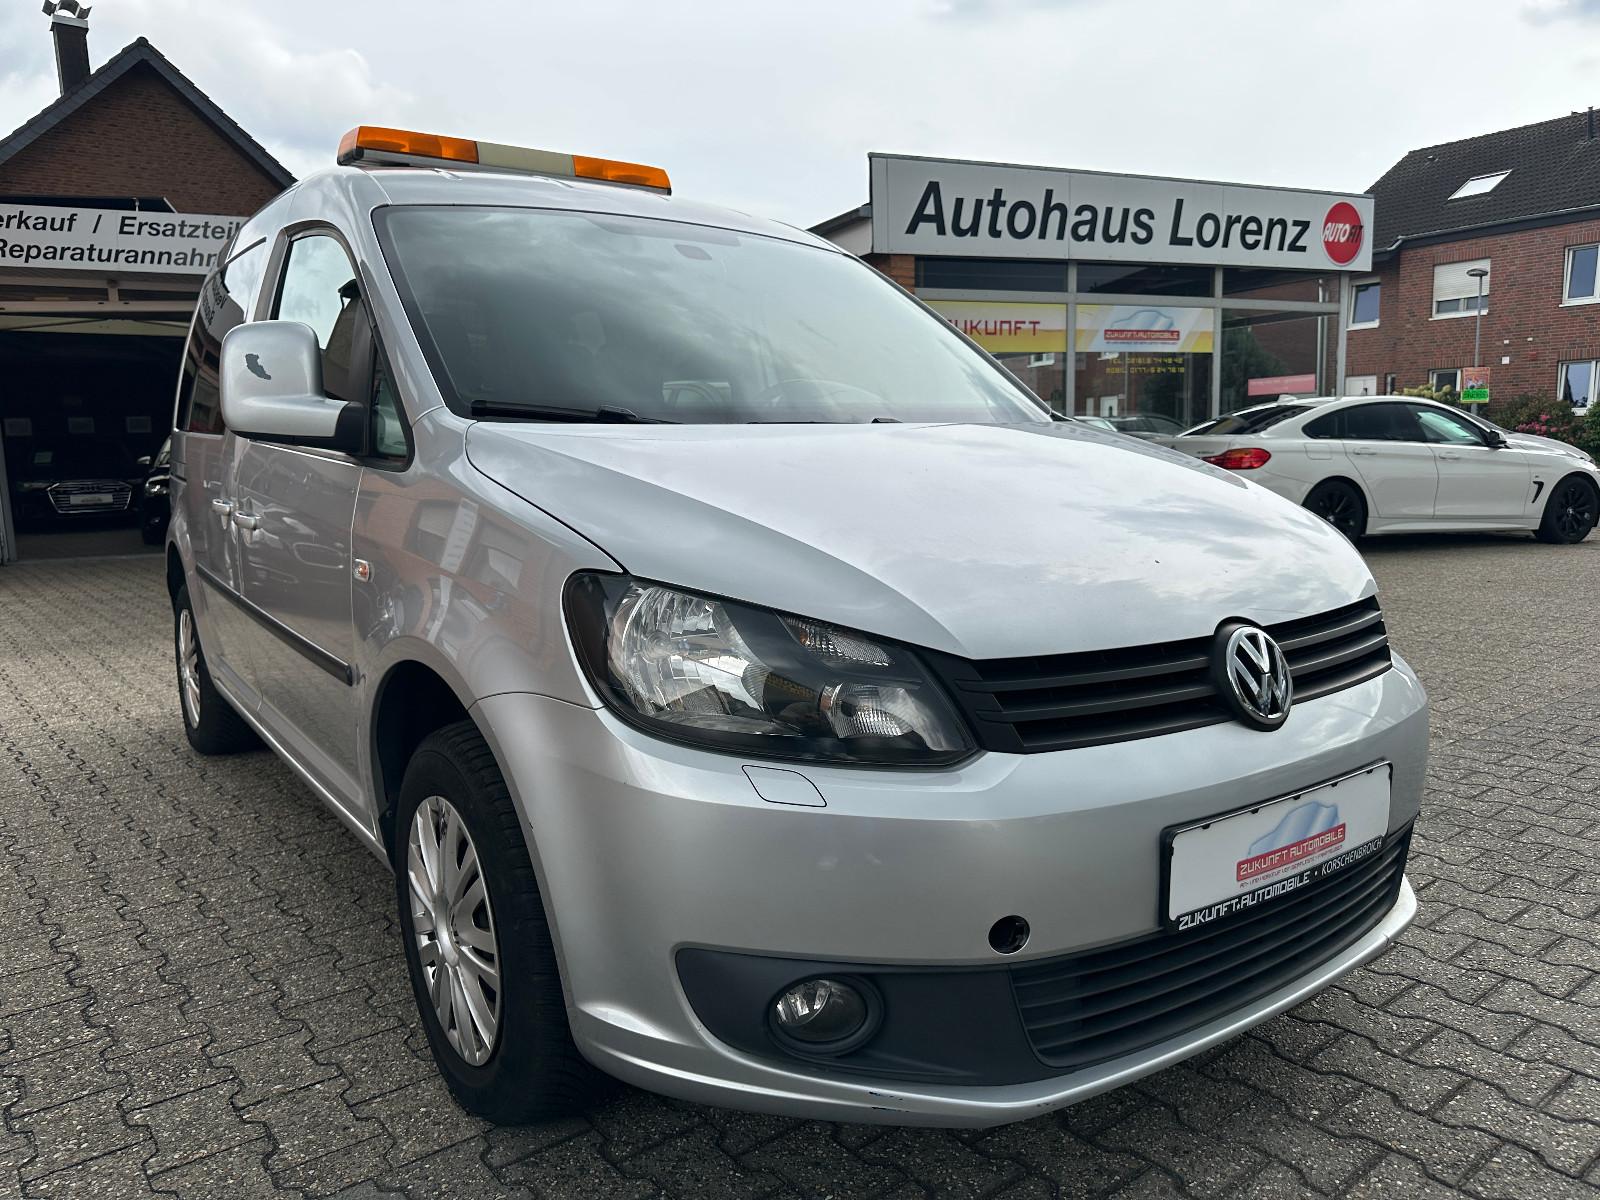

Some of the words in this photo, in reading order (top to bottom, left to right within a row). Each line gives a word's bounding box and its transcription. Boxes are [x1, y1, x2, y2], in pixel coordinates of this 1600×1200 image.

[905, 181, 1155, 245] Autohaus
[1169, 198, 1311, 253] Lorenz
[1178, 898, 1239, 931] ZUKUNFT
[1240, 871, 1311, 909] AUTOMOBILE
[1321, 838, 1382, 876] KORSCHENBROICH
[1240, 850, 1288, 875] ZUKUNFT
[1290, 828, 1343, 857] AUTOMOBILE
